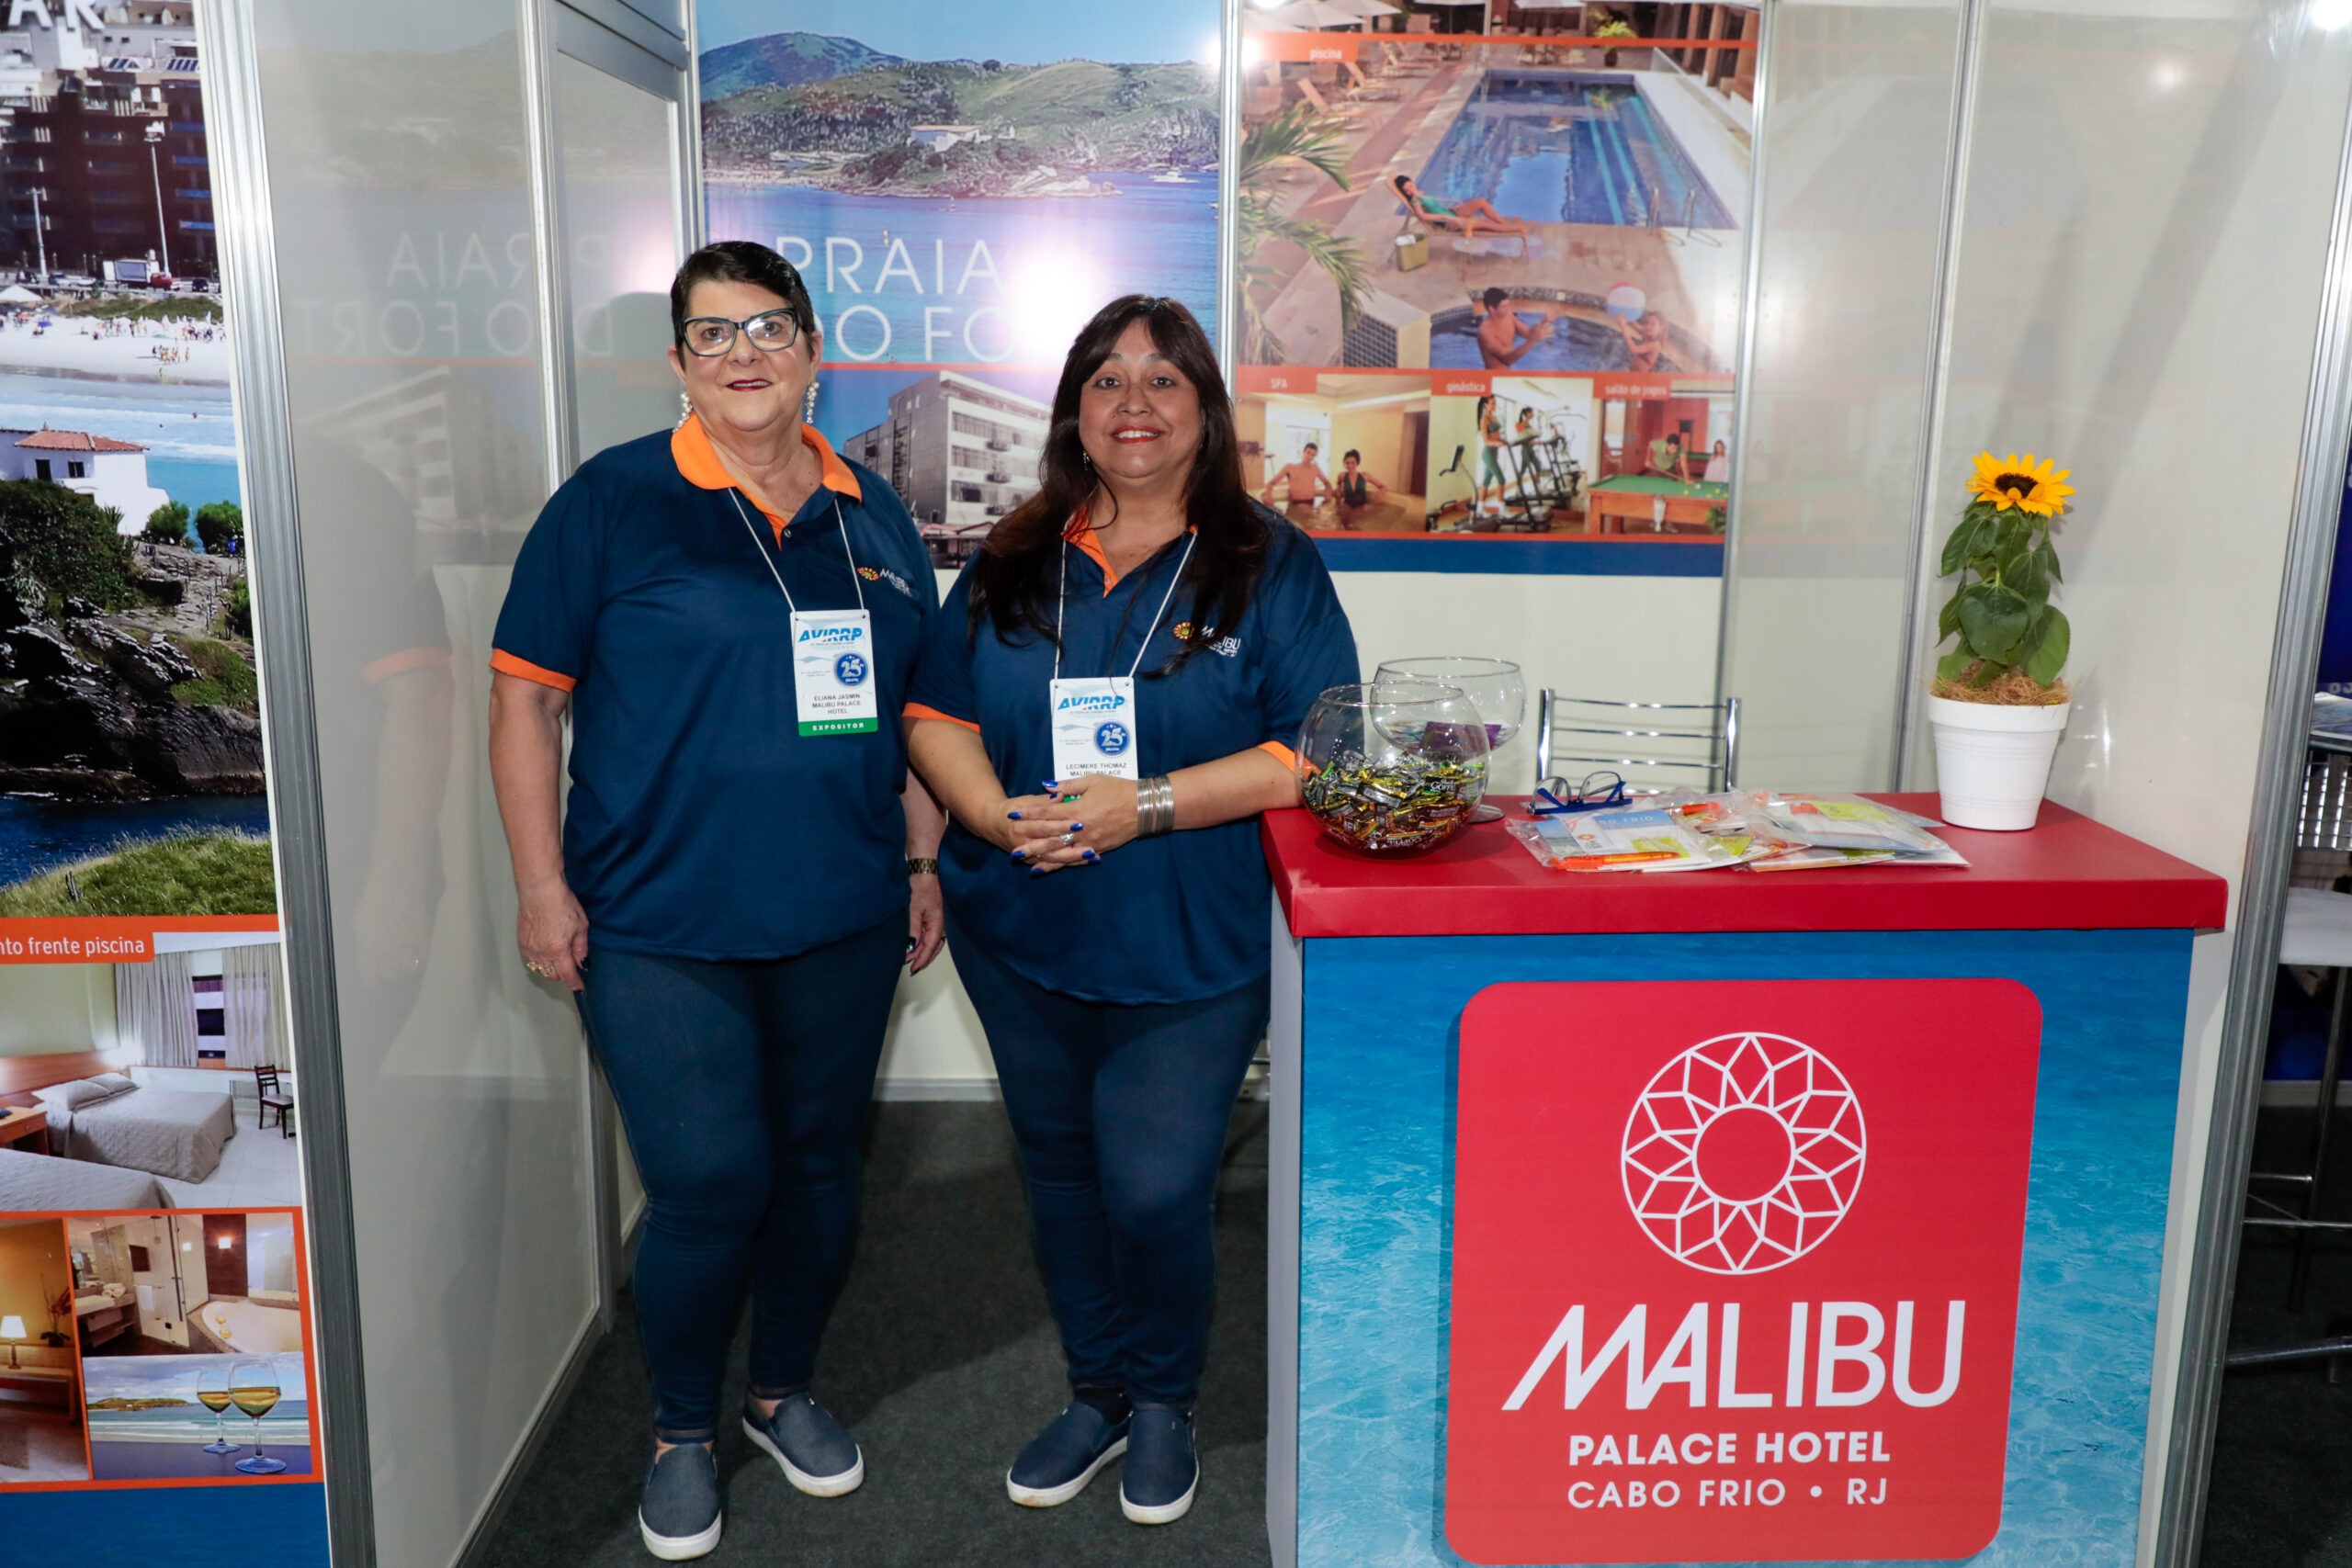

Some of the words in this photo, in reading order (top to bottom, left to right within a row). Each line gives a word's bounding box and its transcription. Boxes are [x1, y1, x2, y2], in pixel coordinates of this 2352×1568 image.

[776, 236, 1005, 294] PRAIA
[1270, 378, 1288, 389] SPA
[1446, 380, 1486, 394] ginástica
[1630, 385, 1641, 395] de
[798, 627, 863, 642] AVIRRP
[1202, 625, 1241, 649] MIBU
[841, 659, 862, 678] 25
[1057, 695, 1125, 710] AVIRRP
[812, 722, 864, 731] EXPOSITOR
[1102, 728, 1123, 747] 25
[28, 937, 80, 955] frente
[85, 936, 144, 958] piscina
[1501, 1301, 1965, 1411] MALIBU
[1568, 1432, 1737, 1466] PALACE
[1756, 1430, 1890, 1463] HOTEL
[1567, 1480, 1680, 1509] CABO
[1699, 1478, 1785, 1506] FRIO
[1847, 1478, 1888, 1506] RJ
